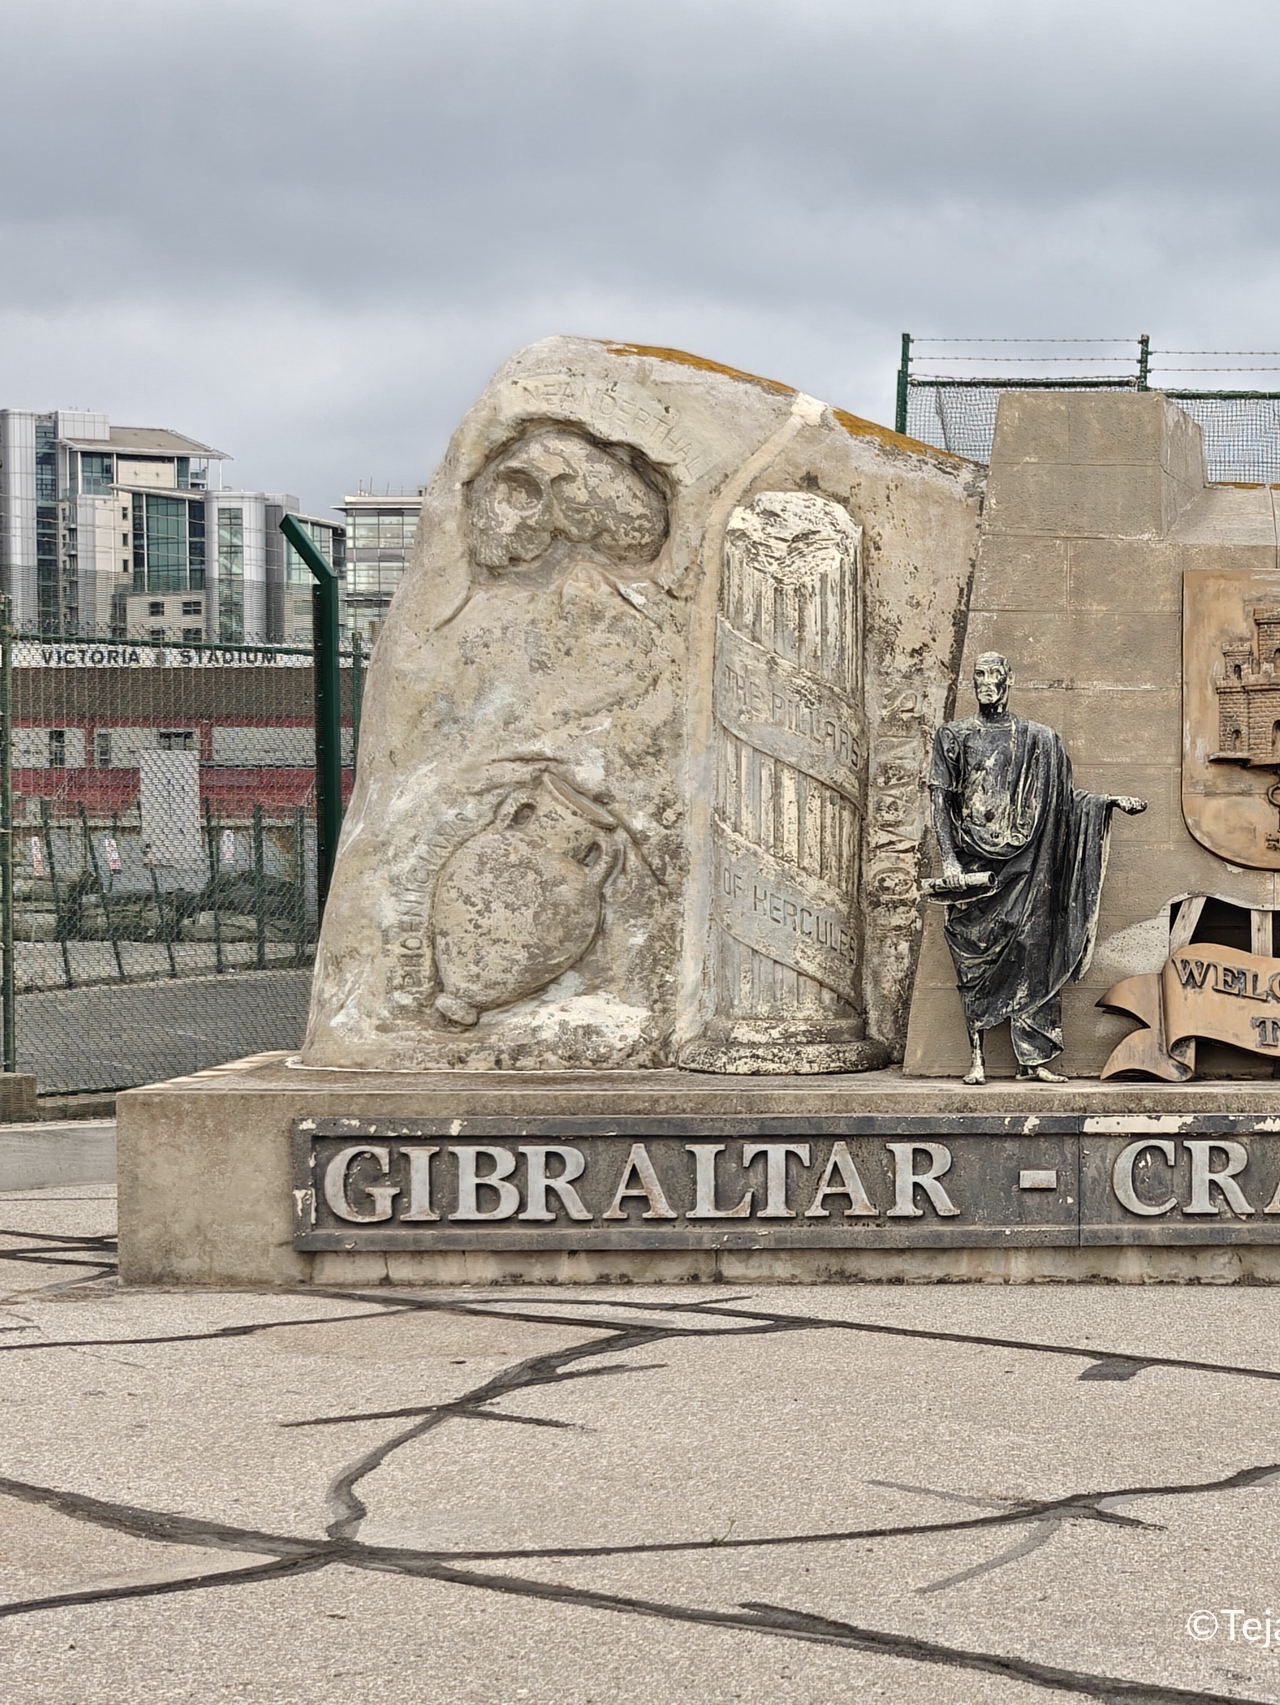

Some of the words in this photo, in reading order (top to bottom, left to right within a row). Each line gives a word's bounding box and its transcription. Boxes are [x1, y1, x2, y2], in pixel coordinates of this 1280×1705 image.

[521, 380, 701, 478] NEANDERTHAL
[42, 649, 140, 665] VICTORIA
[181, 650, 278, 665] STADIUM
[724, 664, 763, 718] THE
[772, 692, 859, 768] PILLARS
[723, 867, 742, 899] OF
[753, 884, 857, 966] HERCULES
[323, 1142, 961, 1224] GIBRALTAR
